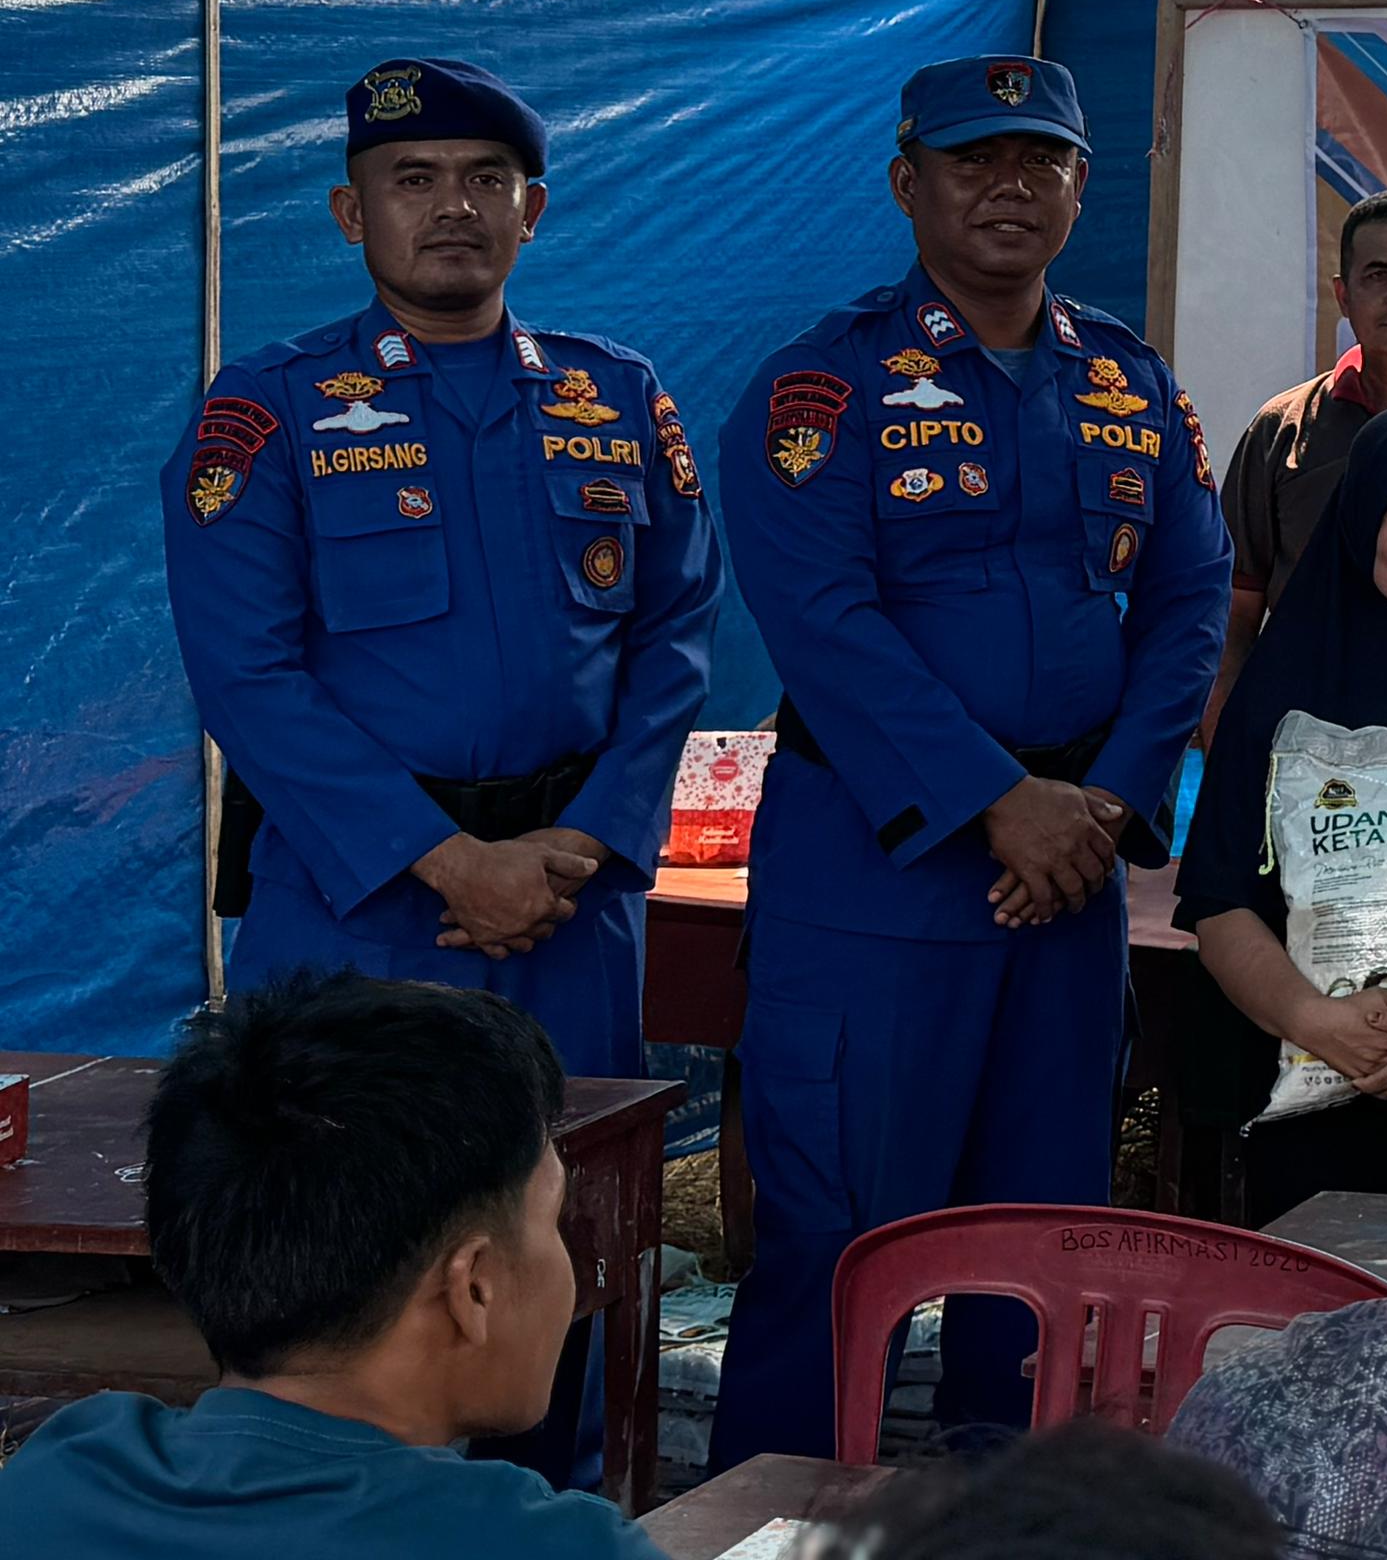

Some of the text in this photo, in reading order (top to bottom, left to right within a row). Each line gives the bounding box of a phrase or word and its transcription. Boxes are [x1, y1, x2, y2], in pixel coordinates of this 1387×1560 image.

[543, 435, 642, 467] POLRI
[881, 420, 984, 450] CIPTO
[1079, 422, 1161, 458] POLRI
[311, 442, 428, 478] H.GIRSANG
[1061, 1228, 1113, 1252] BOS
